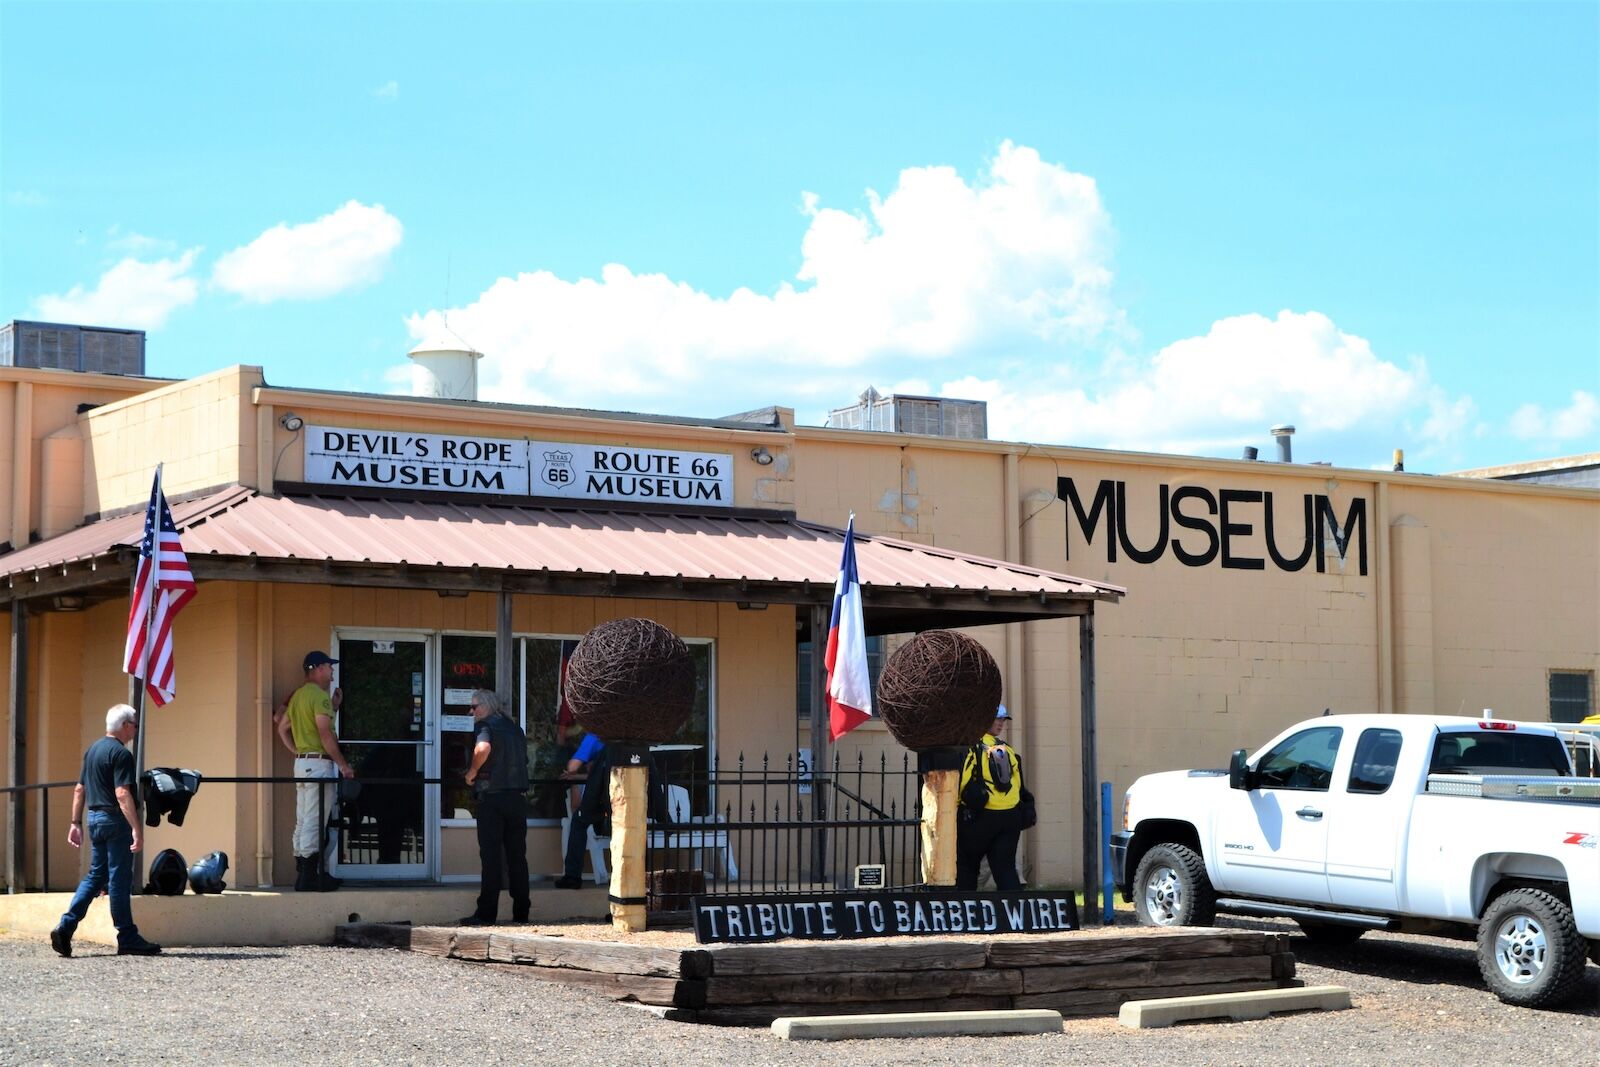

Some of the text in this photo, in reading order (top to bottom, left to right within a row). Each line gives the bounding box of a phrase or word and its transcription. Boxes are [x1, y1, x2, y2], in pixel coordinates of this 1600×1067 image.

[324, 432, 511, 462] DEVIL'S ROPE
[331, 461, 504, 489] MUSEUM
[548, 468, 569, 482] 66
[594, 451, 719, 477] ROUTE 66
[586, 474, 722, 500] MUSEUM
[1057, 476, 1367, 576] MUSEUM
[453, 663, 486, 676] OPEN
[700, 898, 1071, 937] TRIBUTE TO BARBED WIRE
